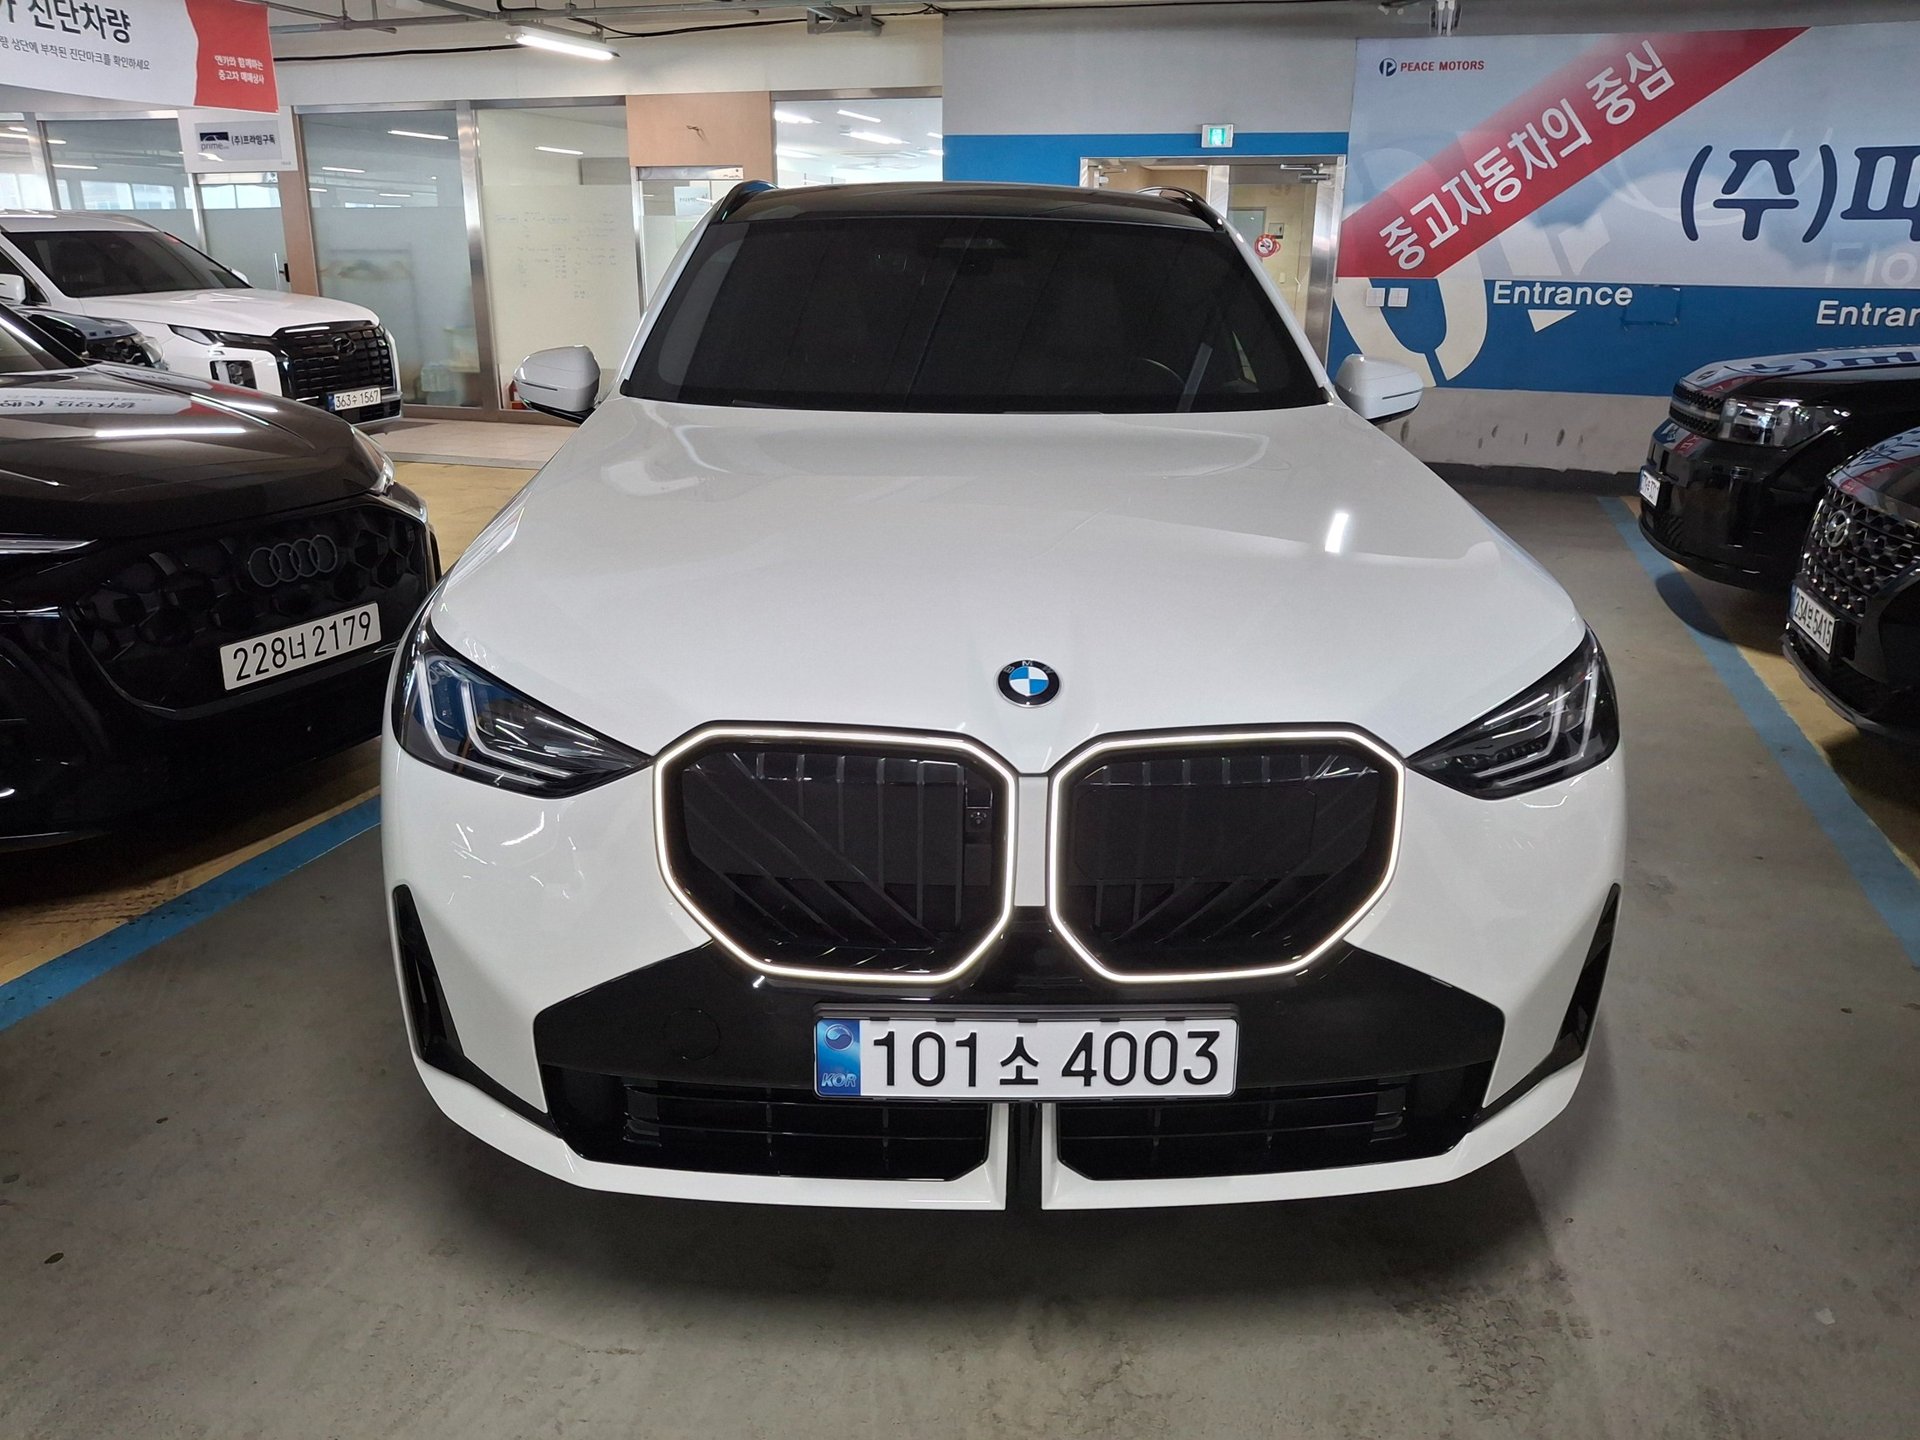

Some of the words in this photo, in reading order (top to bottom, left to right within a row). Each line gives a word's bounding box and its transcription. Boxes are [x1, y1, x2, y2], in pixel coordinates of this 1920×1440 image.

[11, 38, 39, 54] 상단에
[40, 43, 67, 59] 부착된
[69, 48, 111, 66] 진단마크를
[1400, 61, 1435, 72] PEACE
[1439, 59, 1485, 71] MOTORS
[1378, 98, 1593, 270] 중고자동차의
[1585, 39, 1676, 126] 중심
[1493, 280, 1634, 306] Entrance
[360, 390, 379, 404] 1567
[233, 632, 306, 681] 228너
[312, 611, 371, 657] 2179
[873, 1030, 1039, 1087] 101소
[1061, 1030, 1221, 1087] 4003
[821, 1072, 857, 1088] KOR
